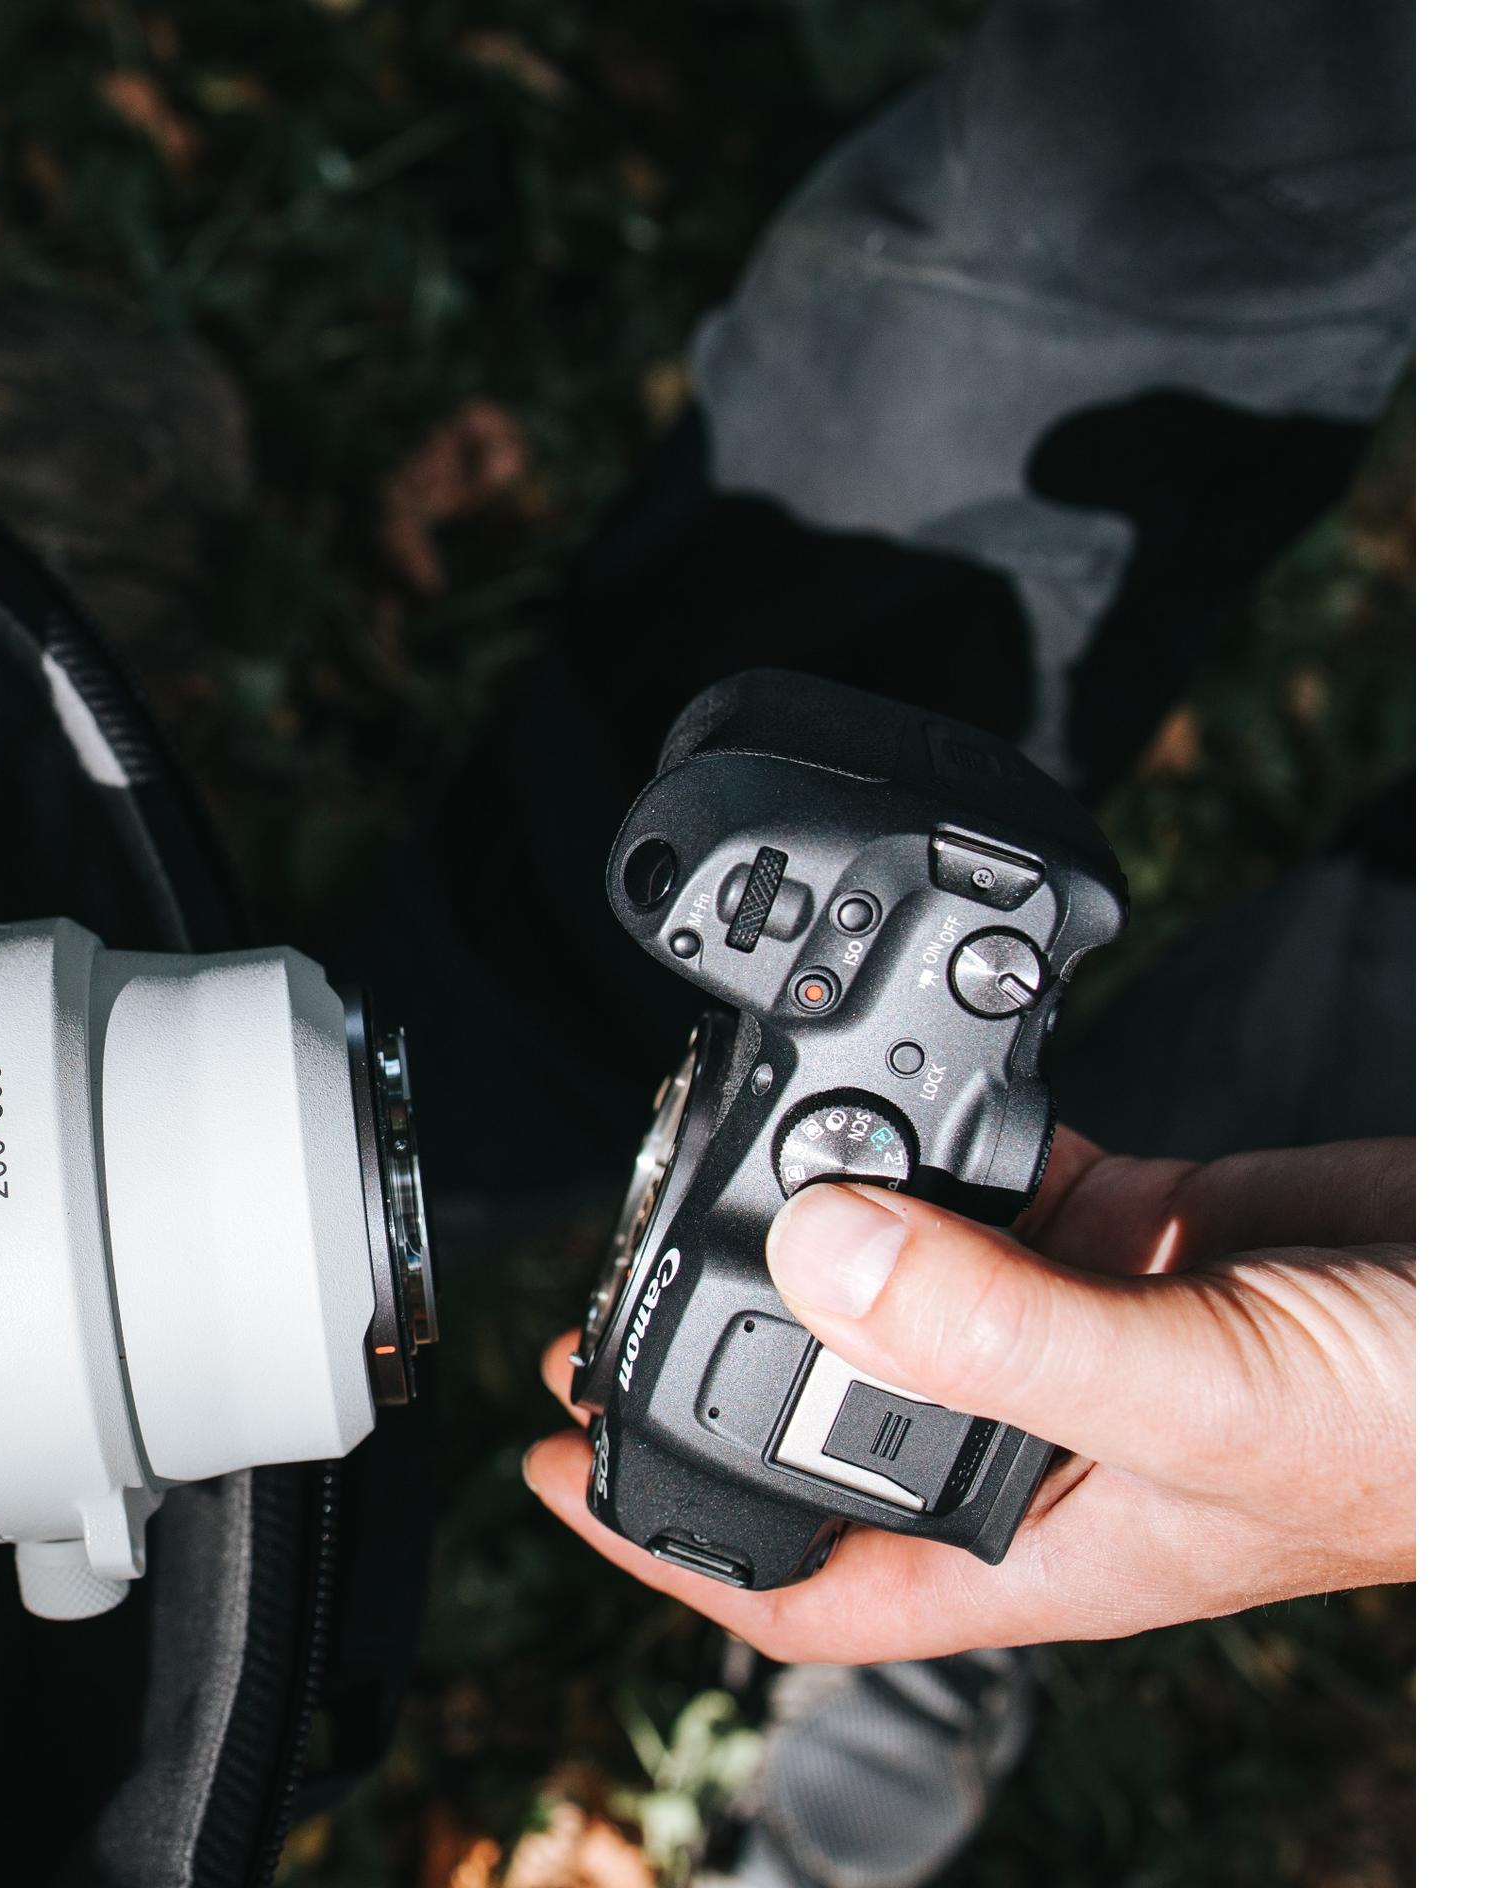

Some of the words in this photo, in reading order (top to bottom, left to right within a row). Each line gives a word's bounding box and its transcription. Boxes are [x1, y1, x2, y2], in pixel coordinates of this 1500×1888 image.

[687, 893, 711, 927] M-Fn
[940, 915, 963, 942] OFF
[843, 941, 863, 966] ISO
[923, 941, 943, 964] ON
[920, 1063, 947, 1100] LOCK
[848, 1112, 872, 1142] SCN
[619, 1248, 681, 1392] Canon
